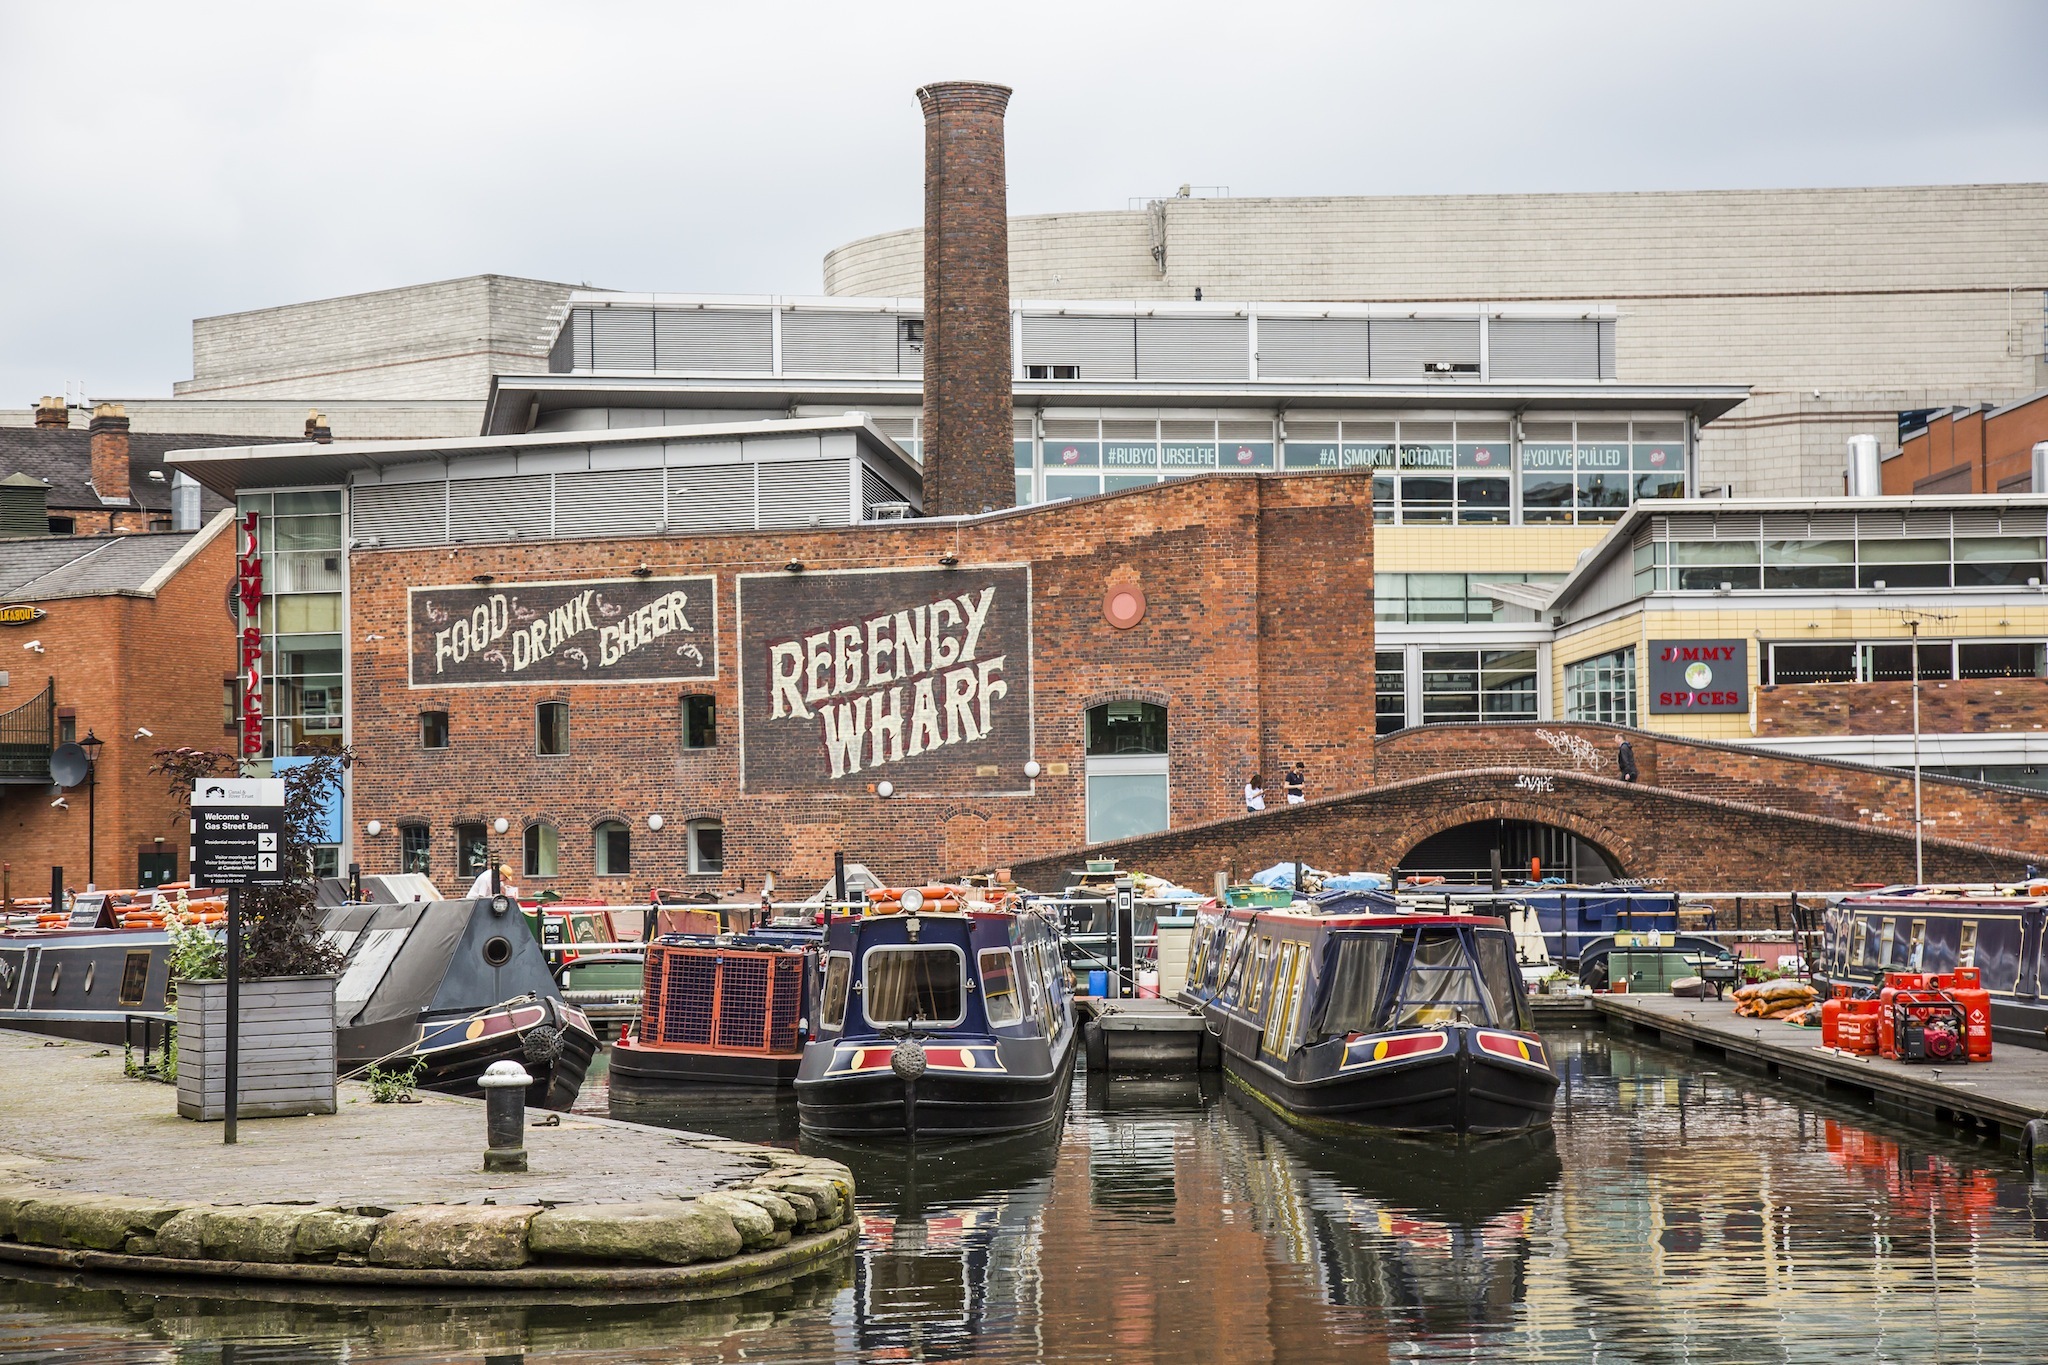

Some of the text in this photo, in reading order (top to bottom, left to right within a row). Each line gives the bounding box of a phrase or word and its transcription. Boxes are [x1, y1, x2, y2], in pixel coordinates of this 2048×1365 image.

[1400, 448, 1452, 466] HOTDATE
[1522, 448, 1620, 466] #YOU'VE PULLED
[434, 589, 694, 674] FOOD DRINK CHEER
[768, 586, 997, 721] REGENCY
[1661, 646, 1736, 662] JIMMY
[1659, 690, 1739, 707] SPICES
[818, 654, 1008, 779] WHARF
[204, 813, 250, 821] Welcome to
[204, 822, 269, 830] Gas Street Basin
